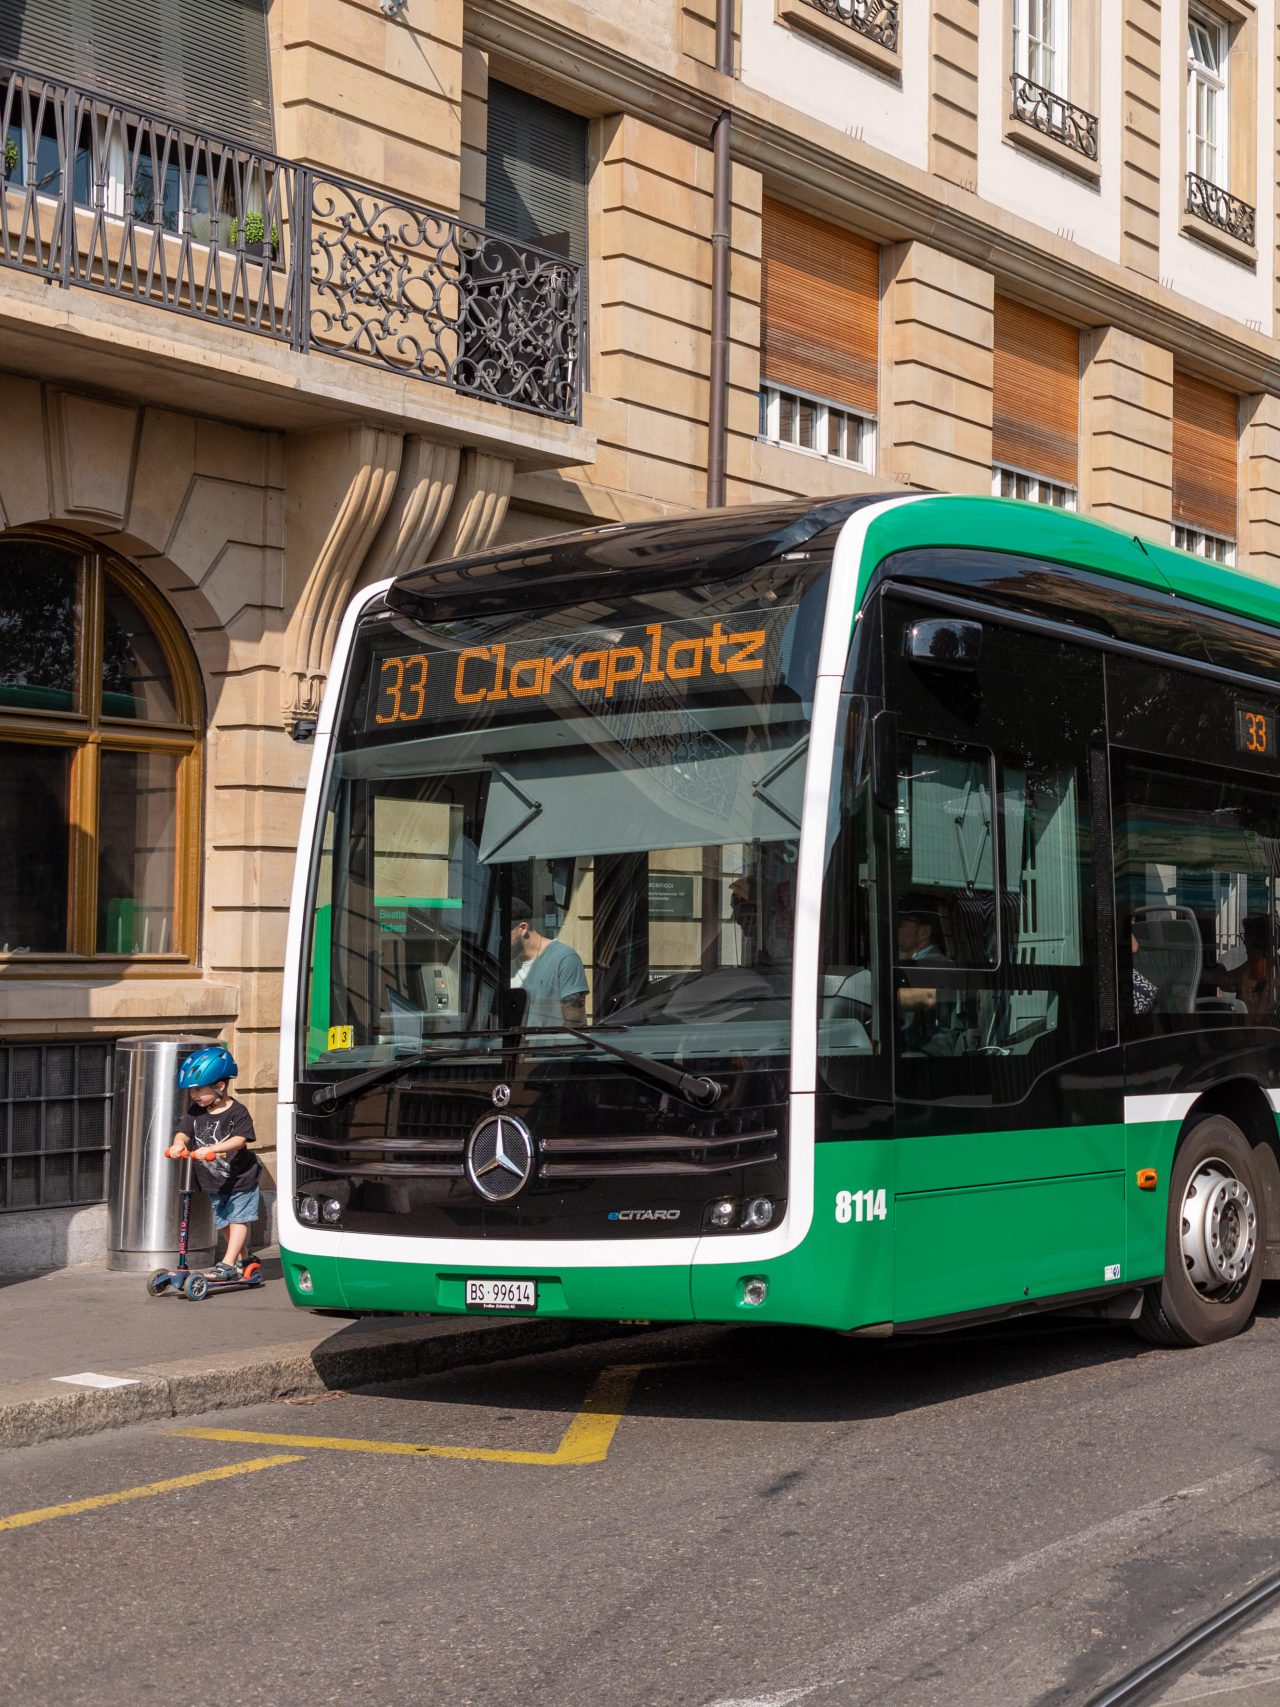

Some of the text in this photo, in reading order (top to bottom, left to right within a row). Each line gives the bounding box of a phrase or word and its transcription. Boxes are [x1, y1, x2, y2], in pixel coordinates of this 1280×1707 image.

[375, 621, 766, 724] 33 Claraplatz
[1245, 712, 1266, 752] 33
[607, 1210, 681, 1220] eCITARO
[835, 1188, 887, 1223] 8114
